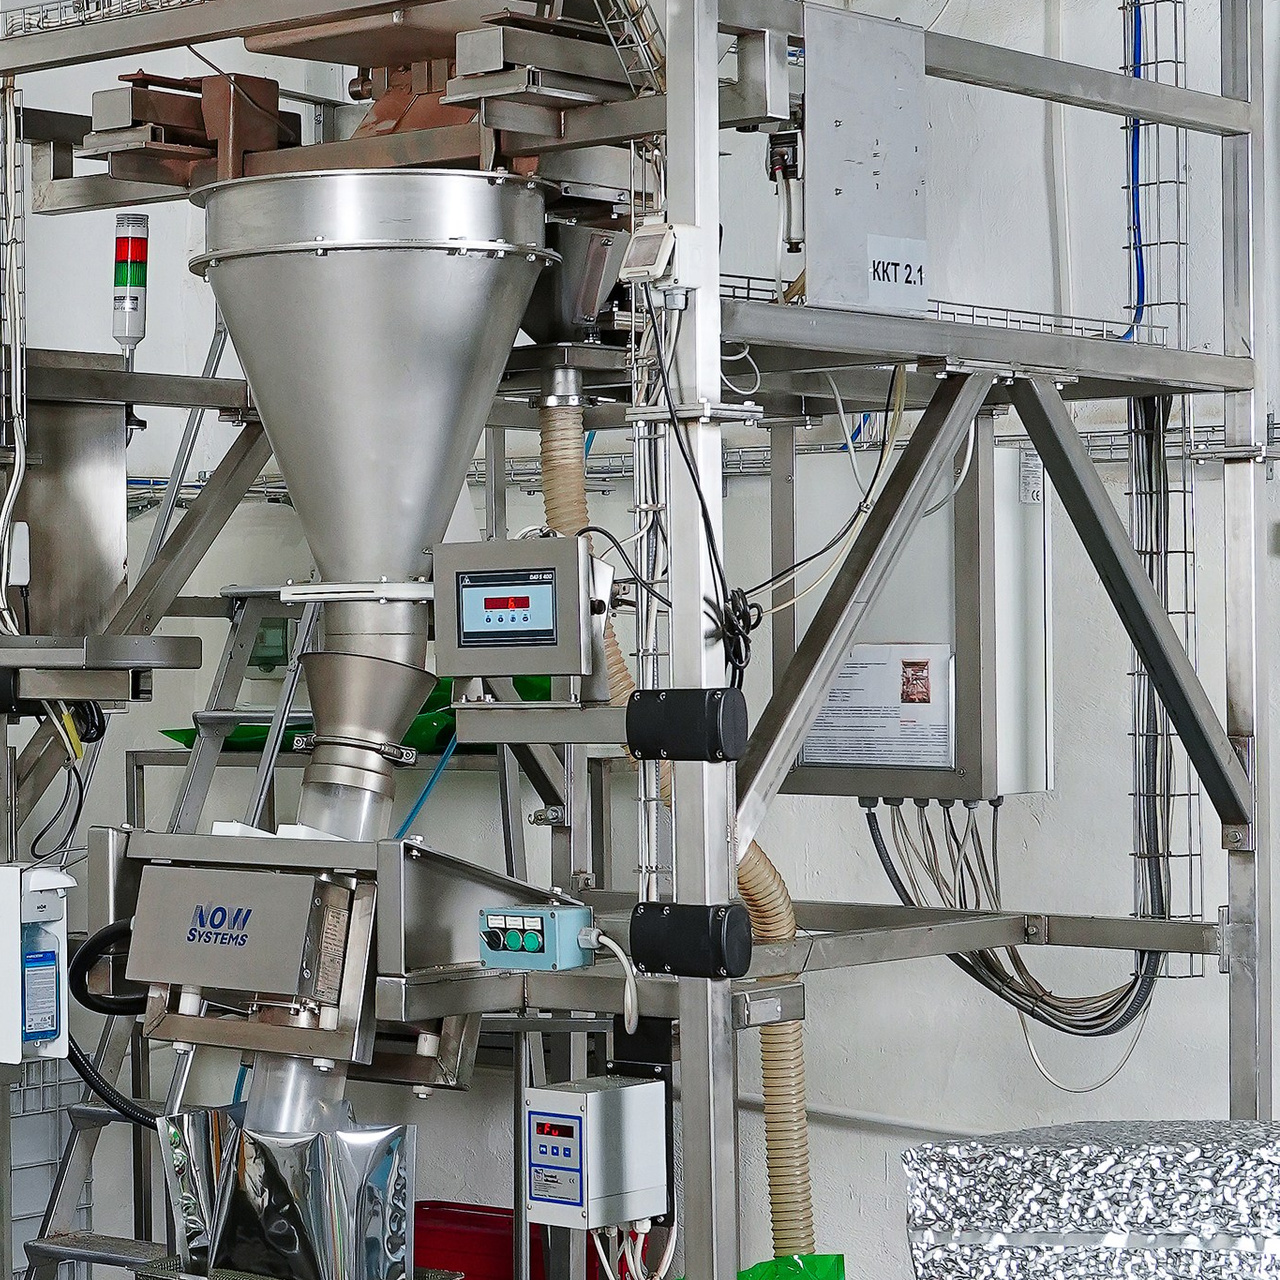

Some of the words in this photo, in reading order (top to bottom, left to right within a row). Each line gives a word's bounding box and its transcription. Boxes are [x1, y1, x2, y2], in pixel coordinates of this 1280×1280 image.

[904, 264, 923, 286] 2.1
[190, 902, 253, 931] NOW
[186, 927, 249, 946] SYSTEMS
